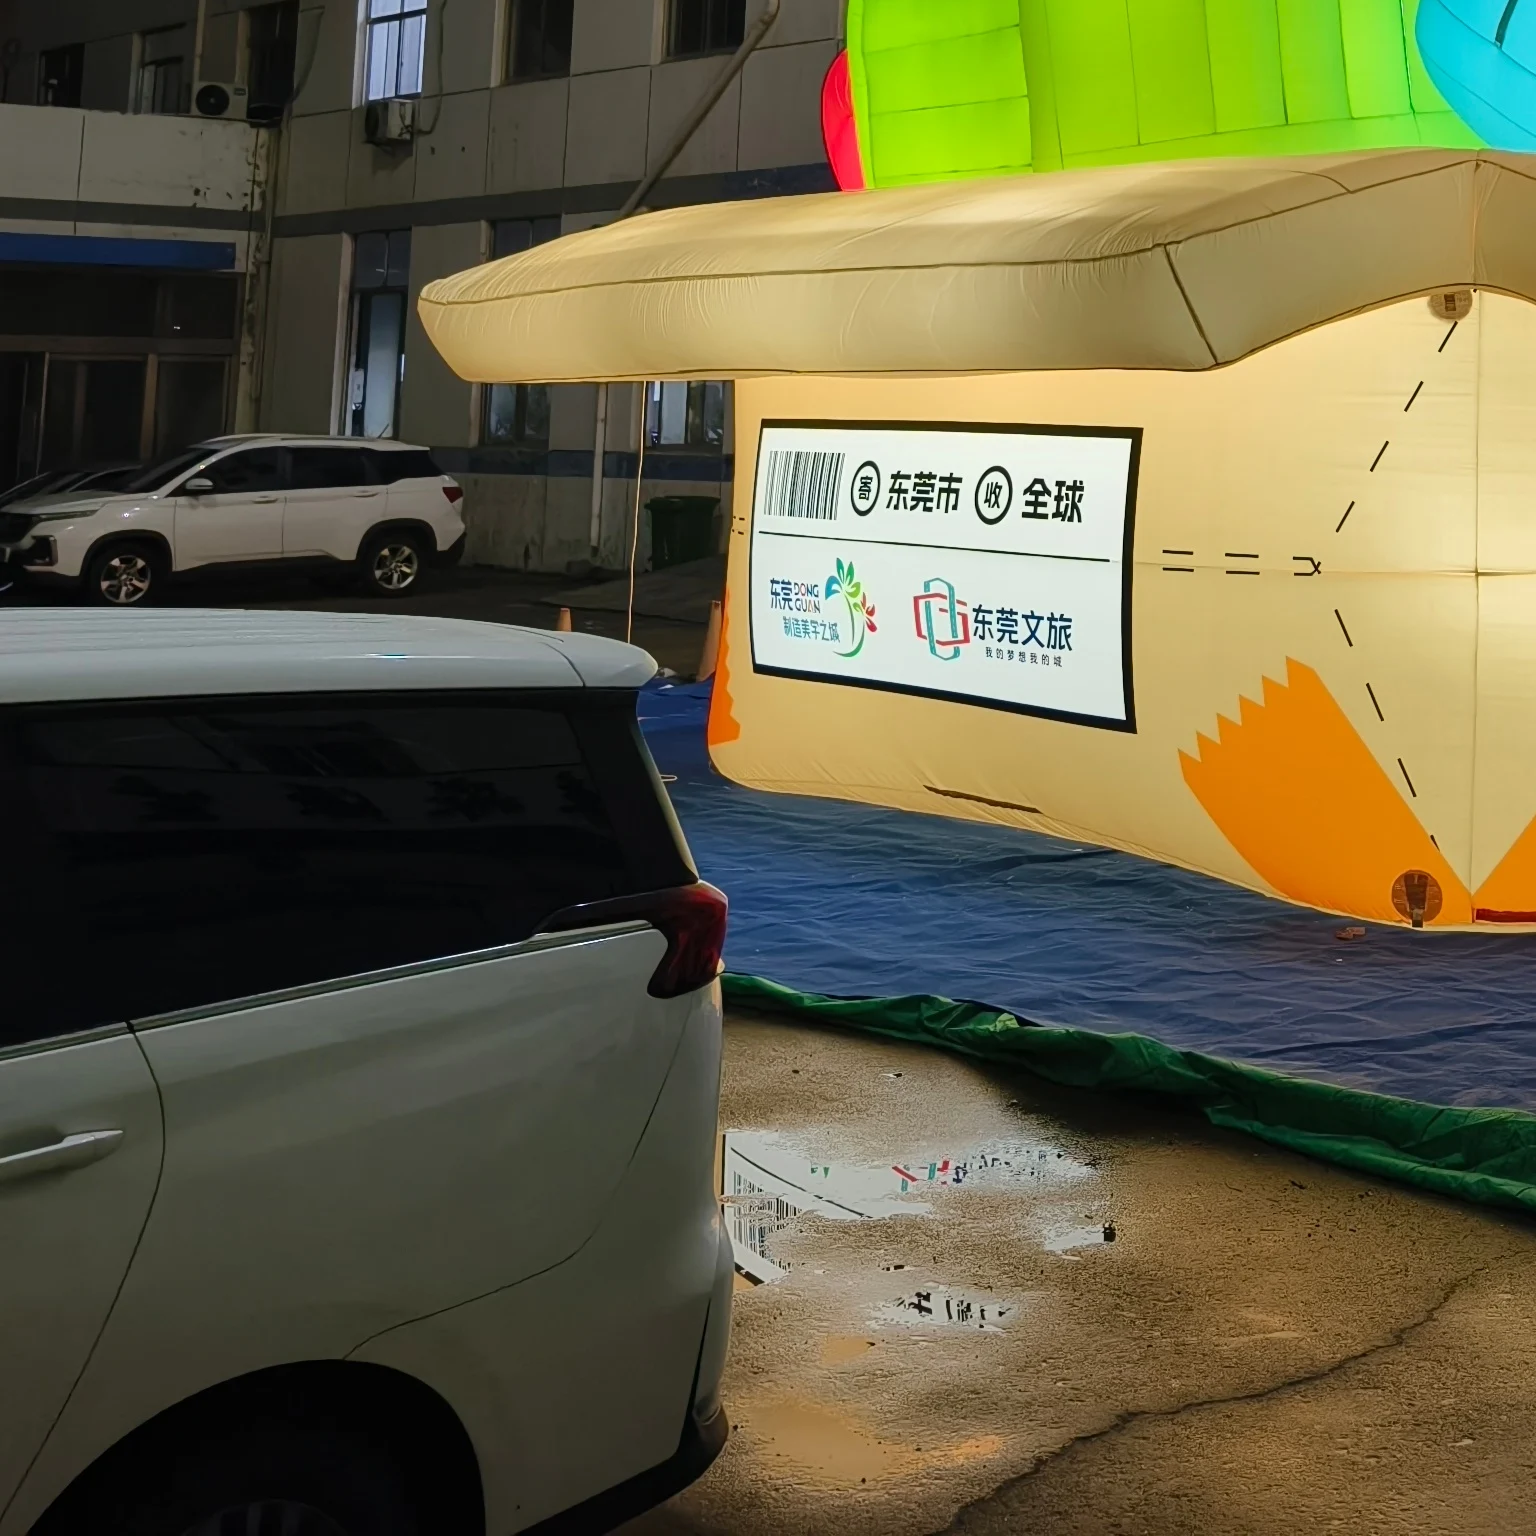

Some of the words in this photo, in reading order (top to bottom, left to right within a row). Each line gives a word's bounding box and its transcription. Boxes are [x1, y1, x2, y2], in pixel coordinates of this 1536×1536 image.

[858, 475, 873, 501] 寄
[886, 470, 963, 514] 东莞市
[984, 481, 1003, 509] 收
[1021, 477, 1085, 523] 全球
[770, 577, 793, 611] 东莞
[793, 582, 819, 598] DONG
[794, 598, 821, 613] GUAN
[972, 603, 1073, 651] 东莞文旅
